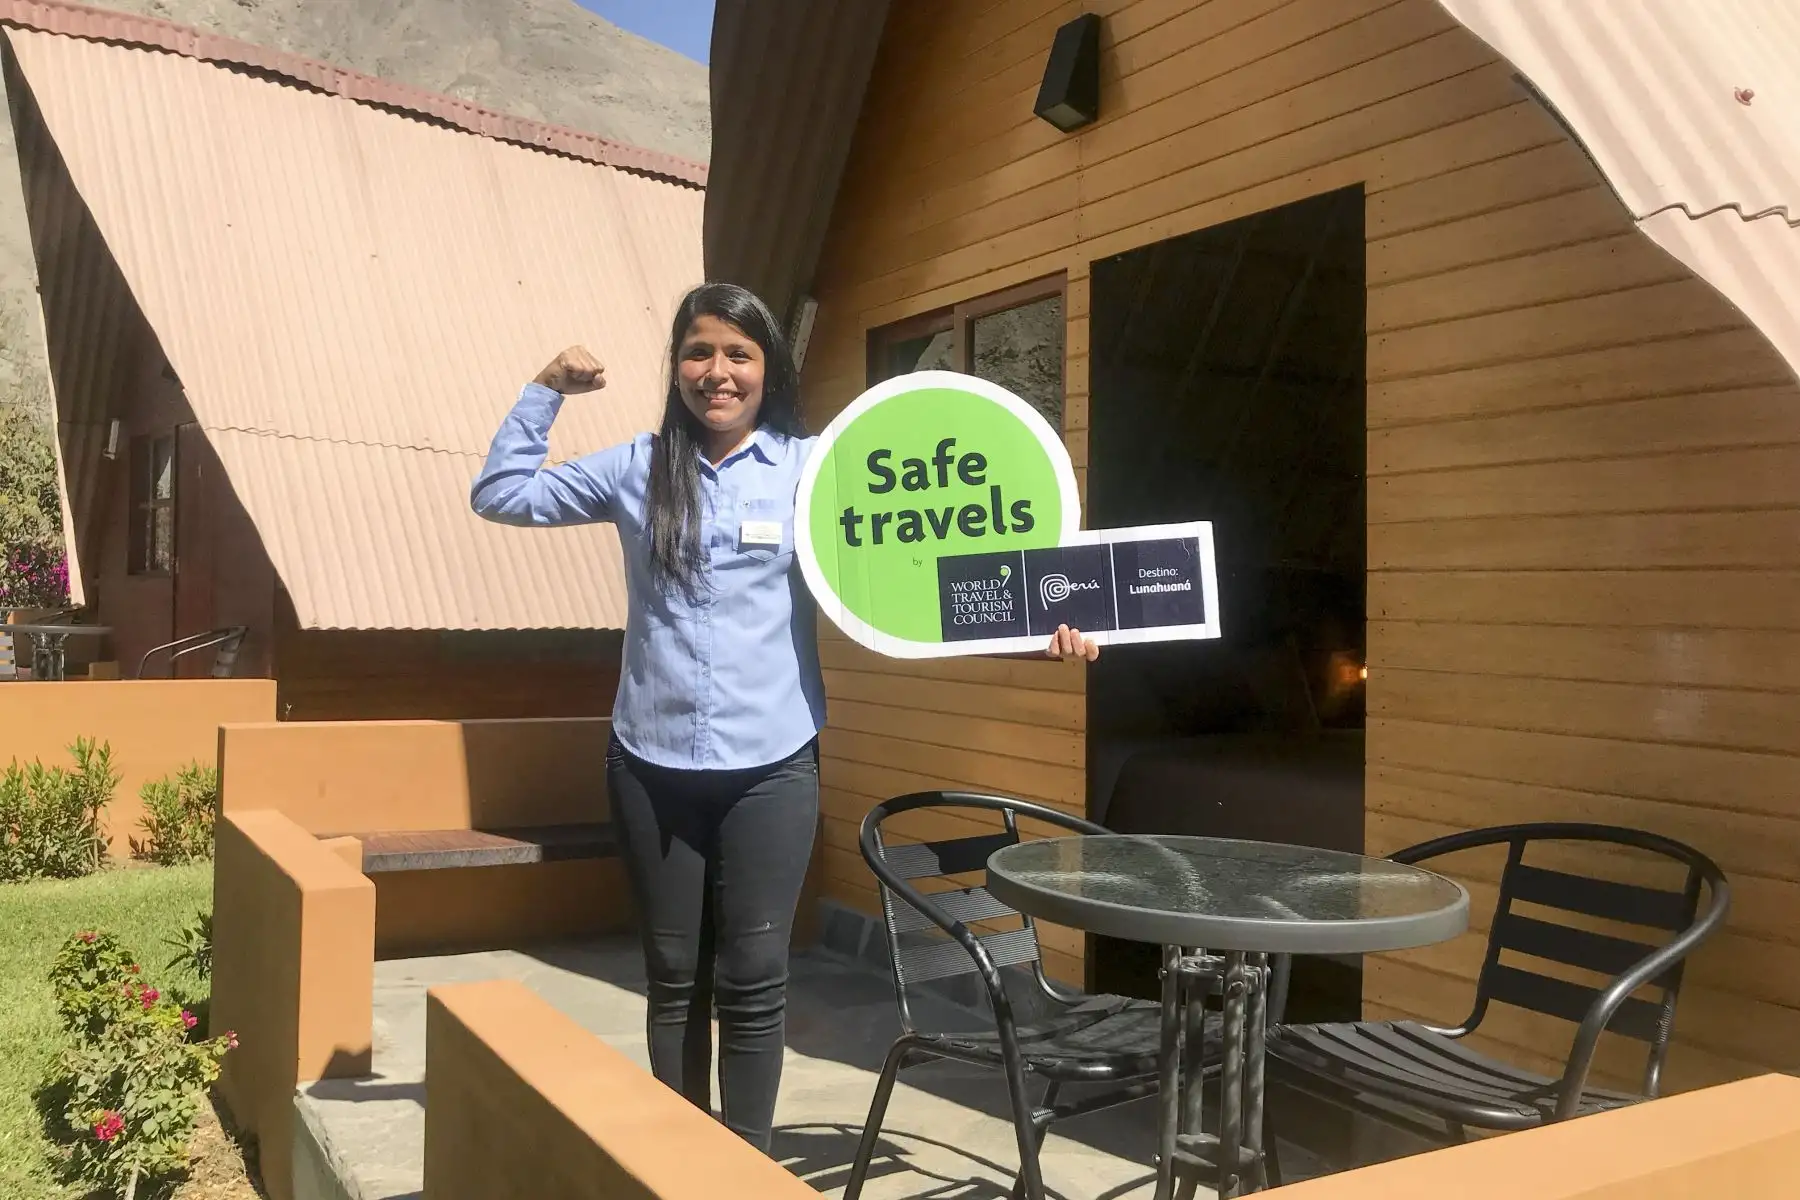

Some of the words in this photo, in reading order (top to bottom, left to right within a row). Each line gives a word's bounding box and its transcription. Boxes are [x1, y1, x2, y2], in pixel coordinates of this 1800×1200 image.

[867, 438, 987, 494] Safe
[839, 485, 1035, 547] travels
[912, 556, 923, 568] by
[1138, 567, 1179, 578] Destino:
[951, 579, 1001, 592] WORLD
[1039, 573, 1100, 611] Perú
[1129, 579, 1191, 595] Lunahuaná
[951, 590, 1002, 604] TRAVEL
[1003, 589, 1013, 599] &
[952, 600, 1013, 614] TOURISM
[953, 612, 1015, 625] COUNCIL
